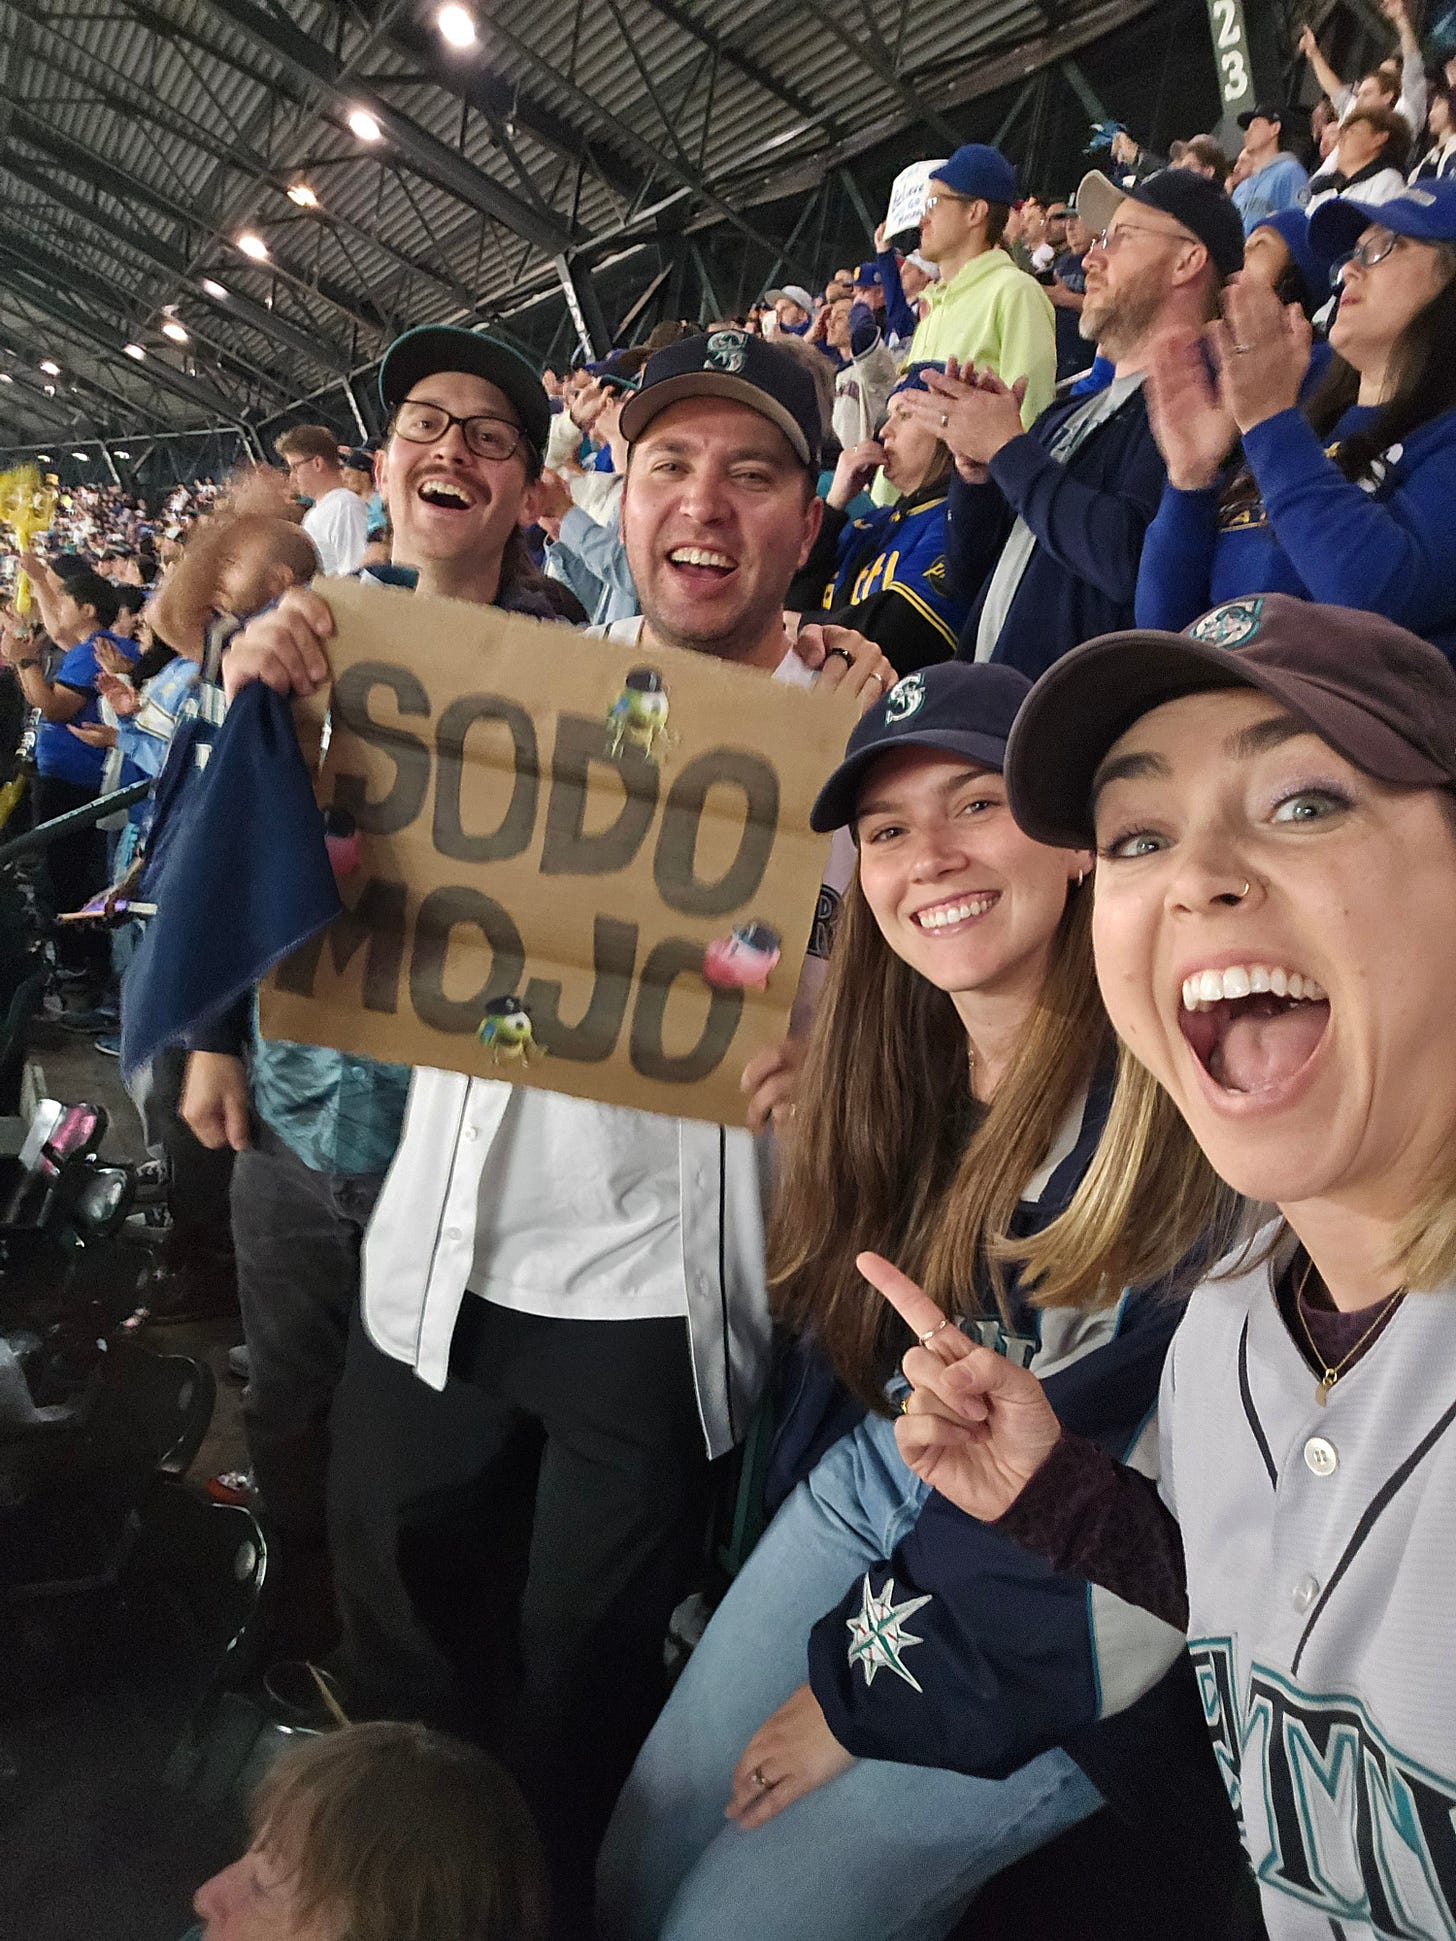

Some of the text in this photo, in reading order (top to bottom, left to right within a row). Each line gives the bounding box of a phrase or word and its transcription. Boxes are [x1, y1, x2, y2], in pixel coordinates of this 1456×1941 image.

[1212, 0, 1248, 101] 23
[332, 661, 781, 918] SODO
[274, 877, 747, 1084] MOJO
